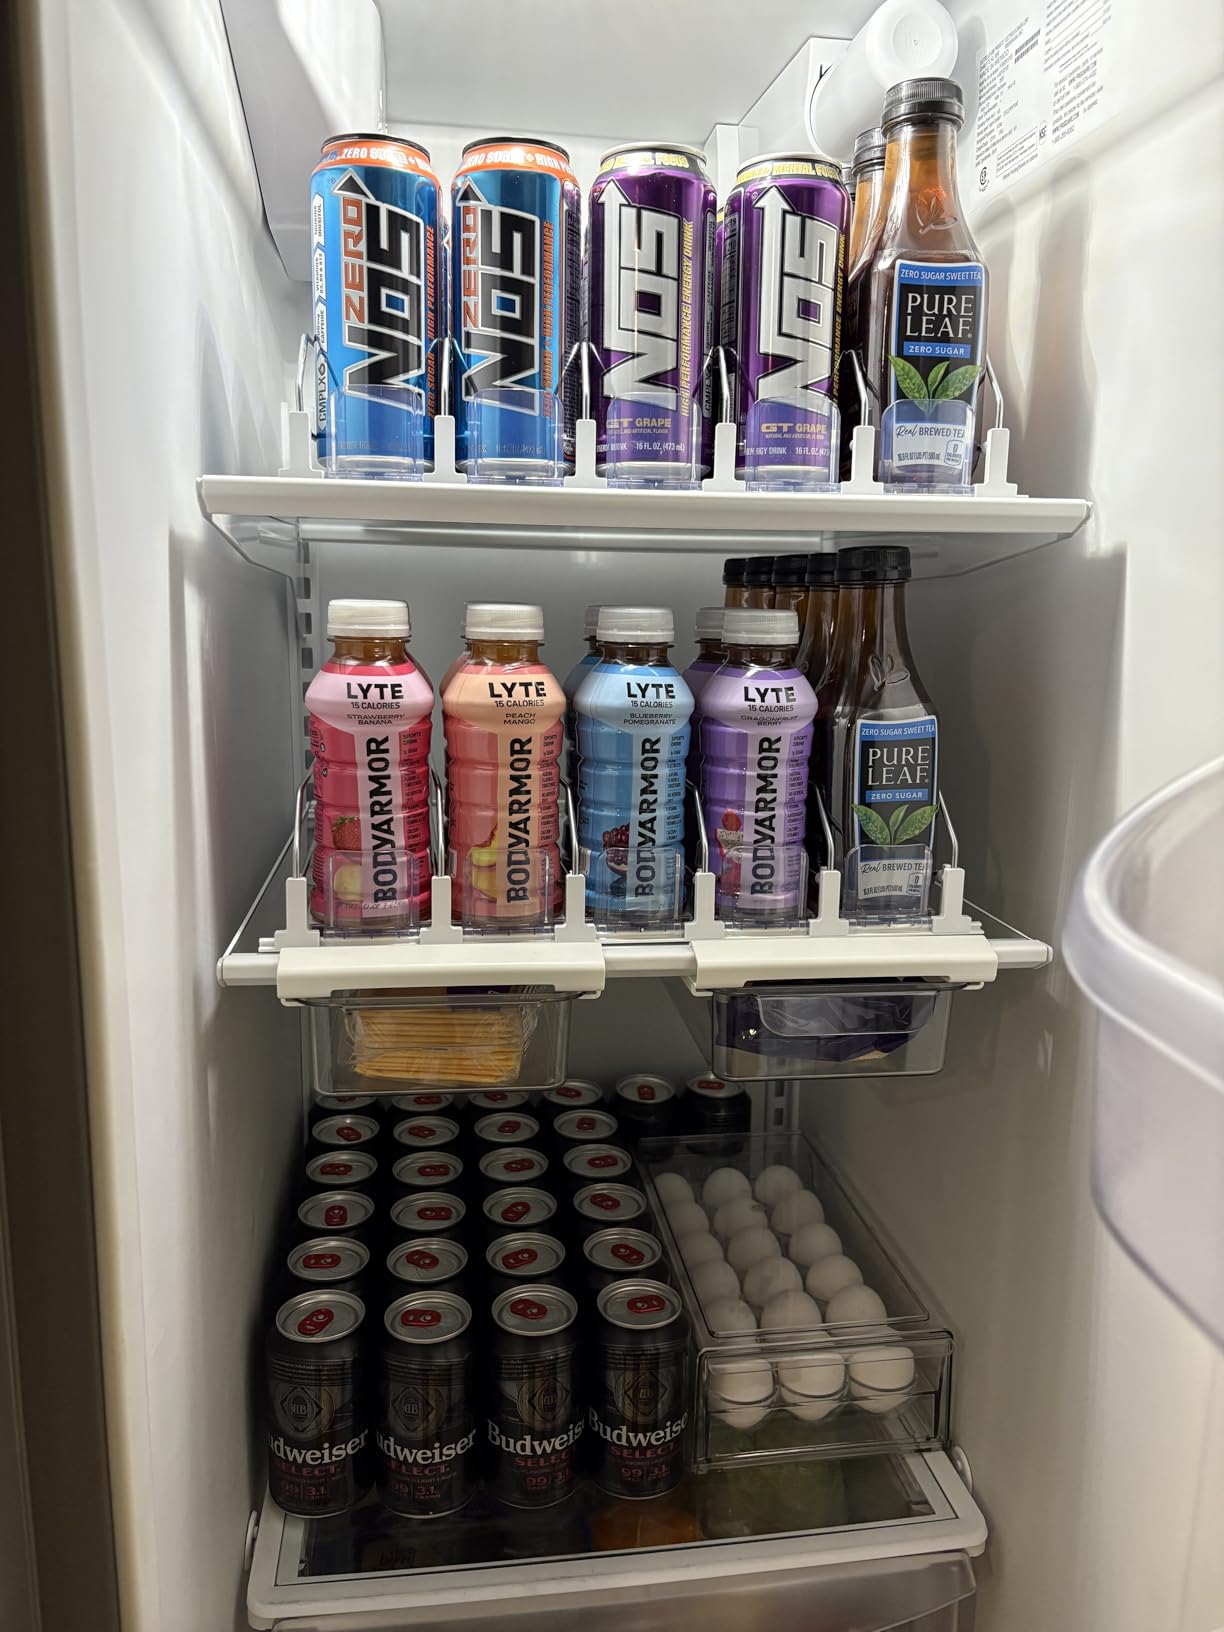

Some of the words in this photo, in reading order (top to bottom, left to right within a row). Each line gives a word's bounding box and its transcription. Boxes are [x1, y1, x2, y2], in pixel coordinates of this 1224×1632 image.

[341, 147, 367, 159] ZERO
[683, 220, 693, 257] DRINK
[342, 197, 367, 324] ZERO
[426, 224, 434, 310] PERFORMANCE
[461, 206, 479, 329] ZERO
[543, 219, 553, 307] PERFORMANCE
[683, 257, 692, 303] ENERGY
[901, 270, 919, 278] ZERO
[921, 272, 944, 280] SUGAR
[946, 272, 968, 280] SWEET
[969, 272, 982, 280] TEA
[341, 190, 426, 417] NOS
[460, 190, 538, 417] NOS
[599, 180, 681, 410] NOS
[752, 186, 837, 417] NOS
[907, 293, 974, 316] PURE
[833, 317, 842, 397] PERFORMANCE
[838, 234, 846, 270] DRINK
[906, 316, 972, 338] LEAF
[681, 303, 691, 390] PERFORMANCE
[936, 346, 964, 355] SUGAR
[427, 351, 435, 391] SUGAR
[318, 363, 327, 422] CMPLX6
[635, 418, 672, 428] GRAPE
[761, 423, 794, 432] GT
[795, 424, 826, 433] GRAPE
[896, 424, 918, 438] Real
[918, 426, 951, 436] BREWED
[636, 442, 643, 450] 16
[662, 442, 675, 452] (473
[768, 446, 787, 454] DRINK
[346, 682, 404, 700] LYTE
[488, 682, 546, 698] LYTE
[626, 682, 676, 699] LYTE
[744, 686, 796, 703] LYTE
[361, 702, 400, 710] CALORIES
[494, 700, 504, 708] 15
[506, 700, 544, 708] CALORIES
[631, 700, 638, 708] 15
[748, 704, 756, 712] 15
[758, 704, 794, 712] CALORIES
[862, 728, 878, 736] ZERO
[880, 728, 902, 736] SUGAR
[904, 726, 924, 734] SWEET
[926, 724, 935, 732] TEA
[868, 746, 930, 766] PURE
[868, 766, 928, 785] LEAF
[366, 736, 398, 903] BODYARMOR
[507, 736, 532, 904] BODYARMOR
[635, 736, 661, 898] BODYARMOR
[751, 736, 782, 896] BODYARMOR
[861, 863, 881, 874] Real
[882, 863, 912, 872] BREWED
[488, 1417, 587, 1456] Budweis
[588, 1406, 689, 1448] Budweise
[514, 1448, 573, 1467] SELEC
[609, 1442, 675, 1458] SELECT
[527, 1476, 548, 1486] 99
